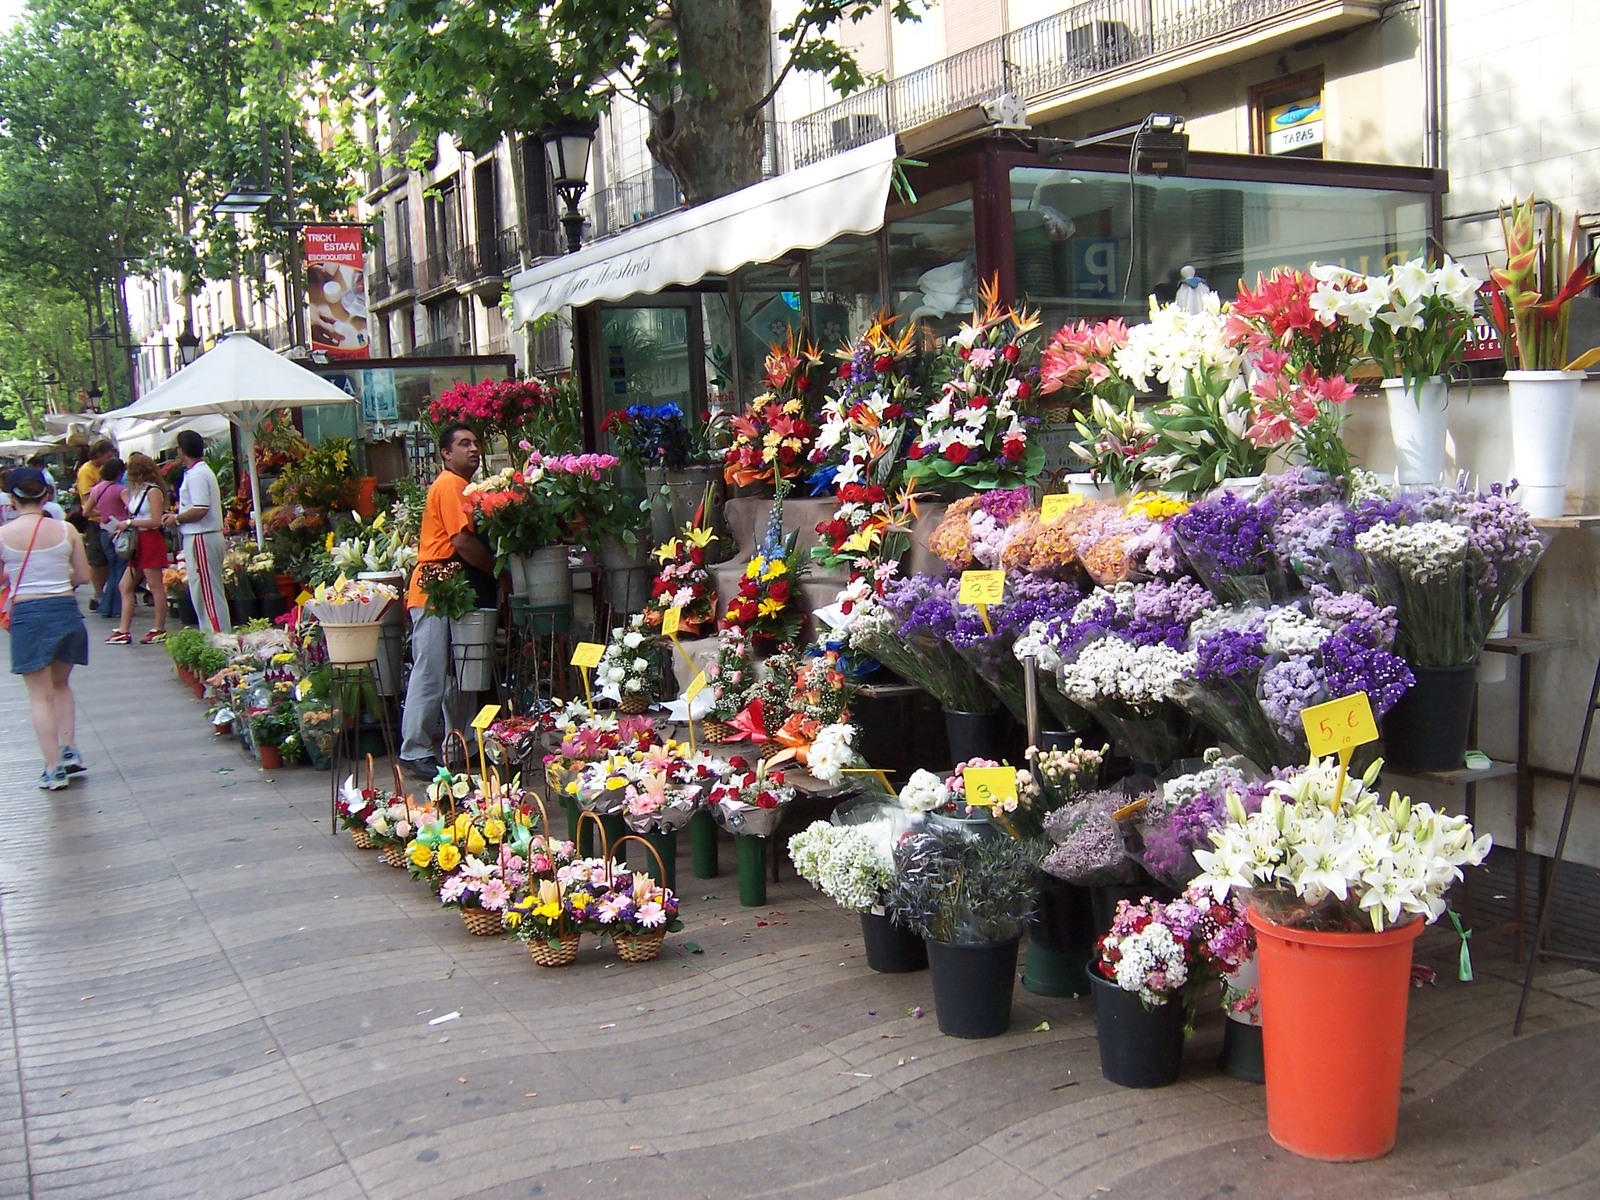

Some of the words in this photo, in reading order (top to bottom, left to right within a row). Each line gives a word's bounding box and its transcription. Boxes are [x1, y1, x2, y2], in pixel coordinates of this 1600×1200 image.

[1283, 128, 1314, 144] TAPAS
[969, 583, 983, 599] 3
[1319, 718, 1333, 742] 5
[1347, 710, 1359, 728] €
[976, 784, 991, 799] 3
